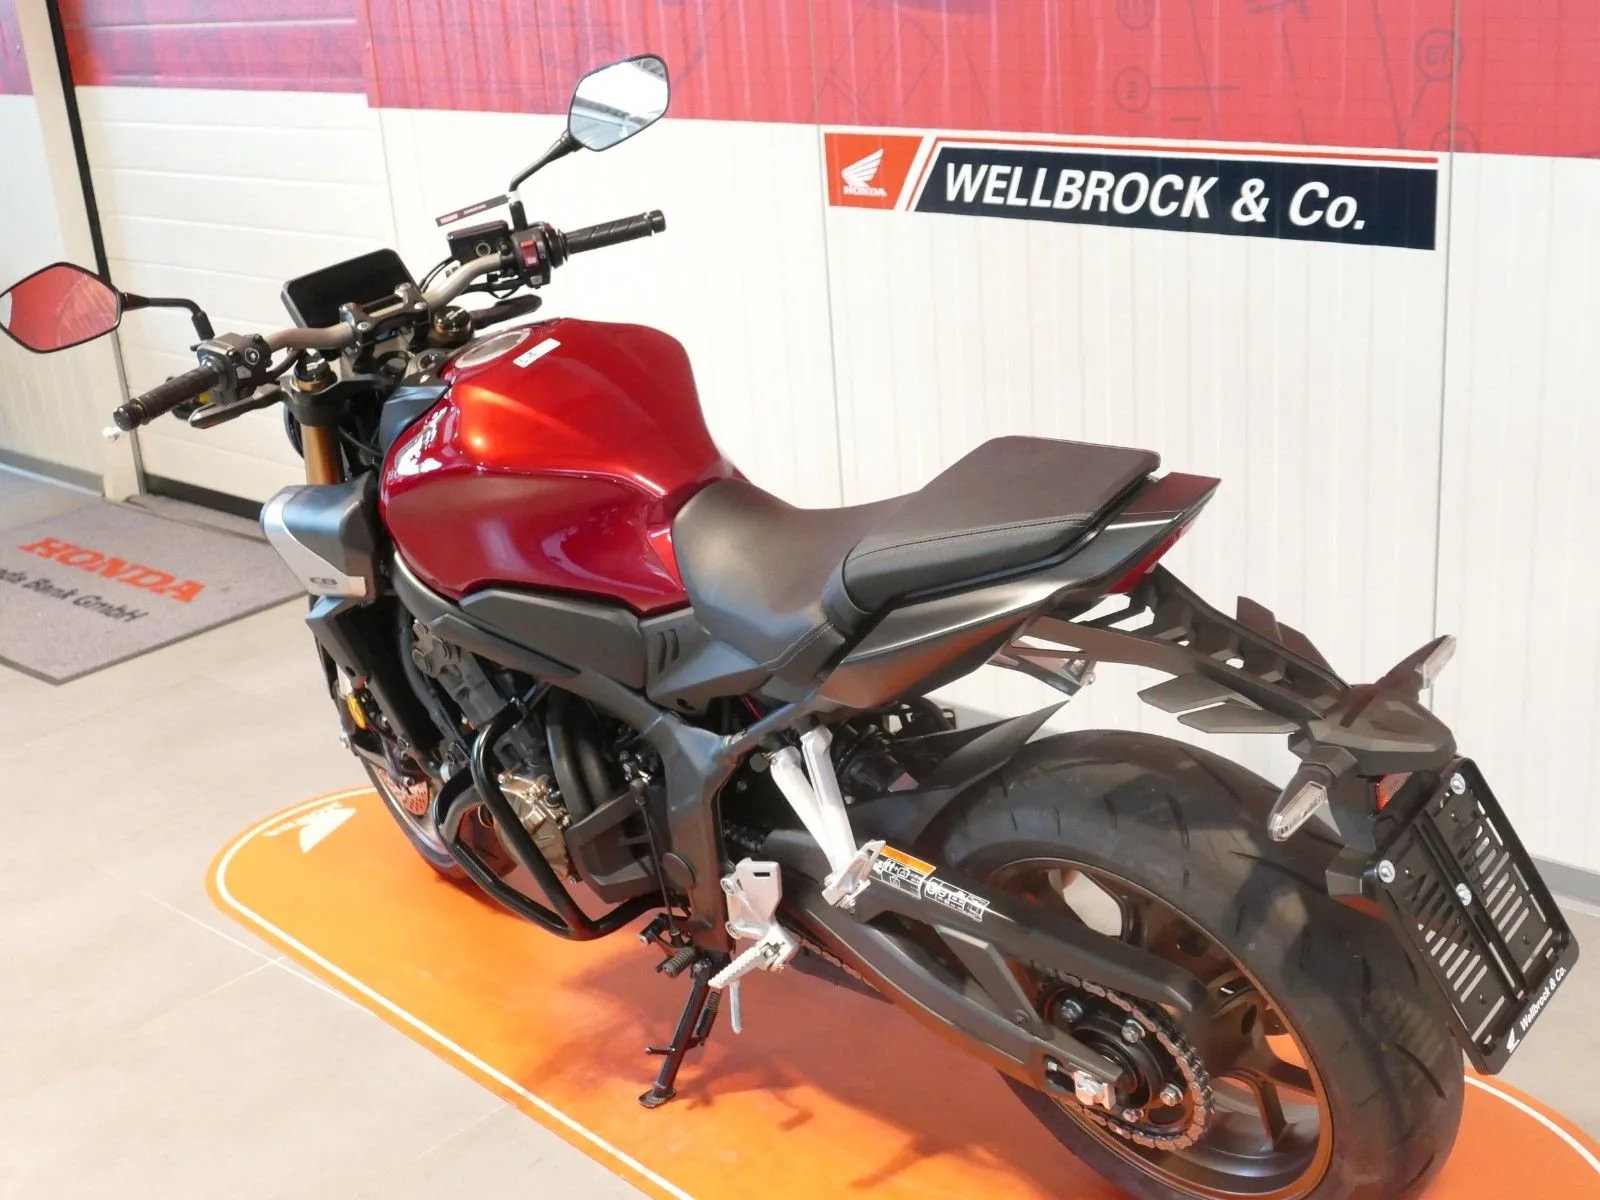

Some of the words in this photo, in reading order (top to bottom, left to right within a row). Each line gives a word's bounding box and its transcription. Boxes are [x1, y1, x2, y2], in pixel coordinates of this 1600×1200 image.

[945, 161, 1220, 220] WELLBROCK
[1230, 177, 1270, 223] &
[1288, 181, 1367, 230] Co.
[18, 537, 205, 603] HONDA
[73, 594, 149, 622] GmbH
[1520, 986, 1550, 1032] Wellbrock
[1549, 977, 1557, 991] &
[1555, 966, 1567, 982] Co.
